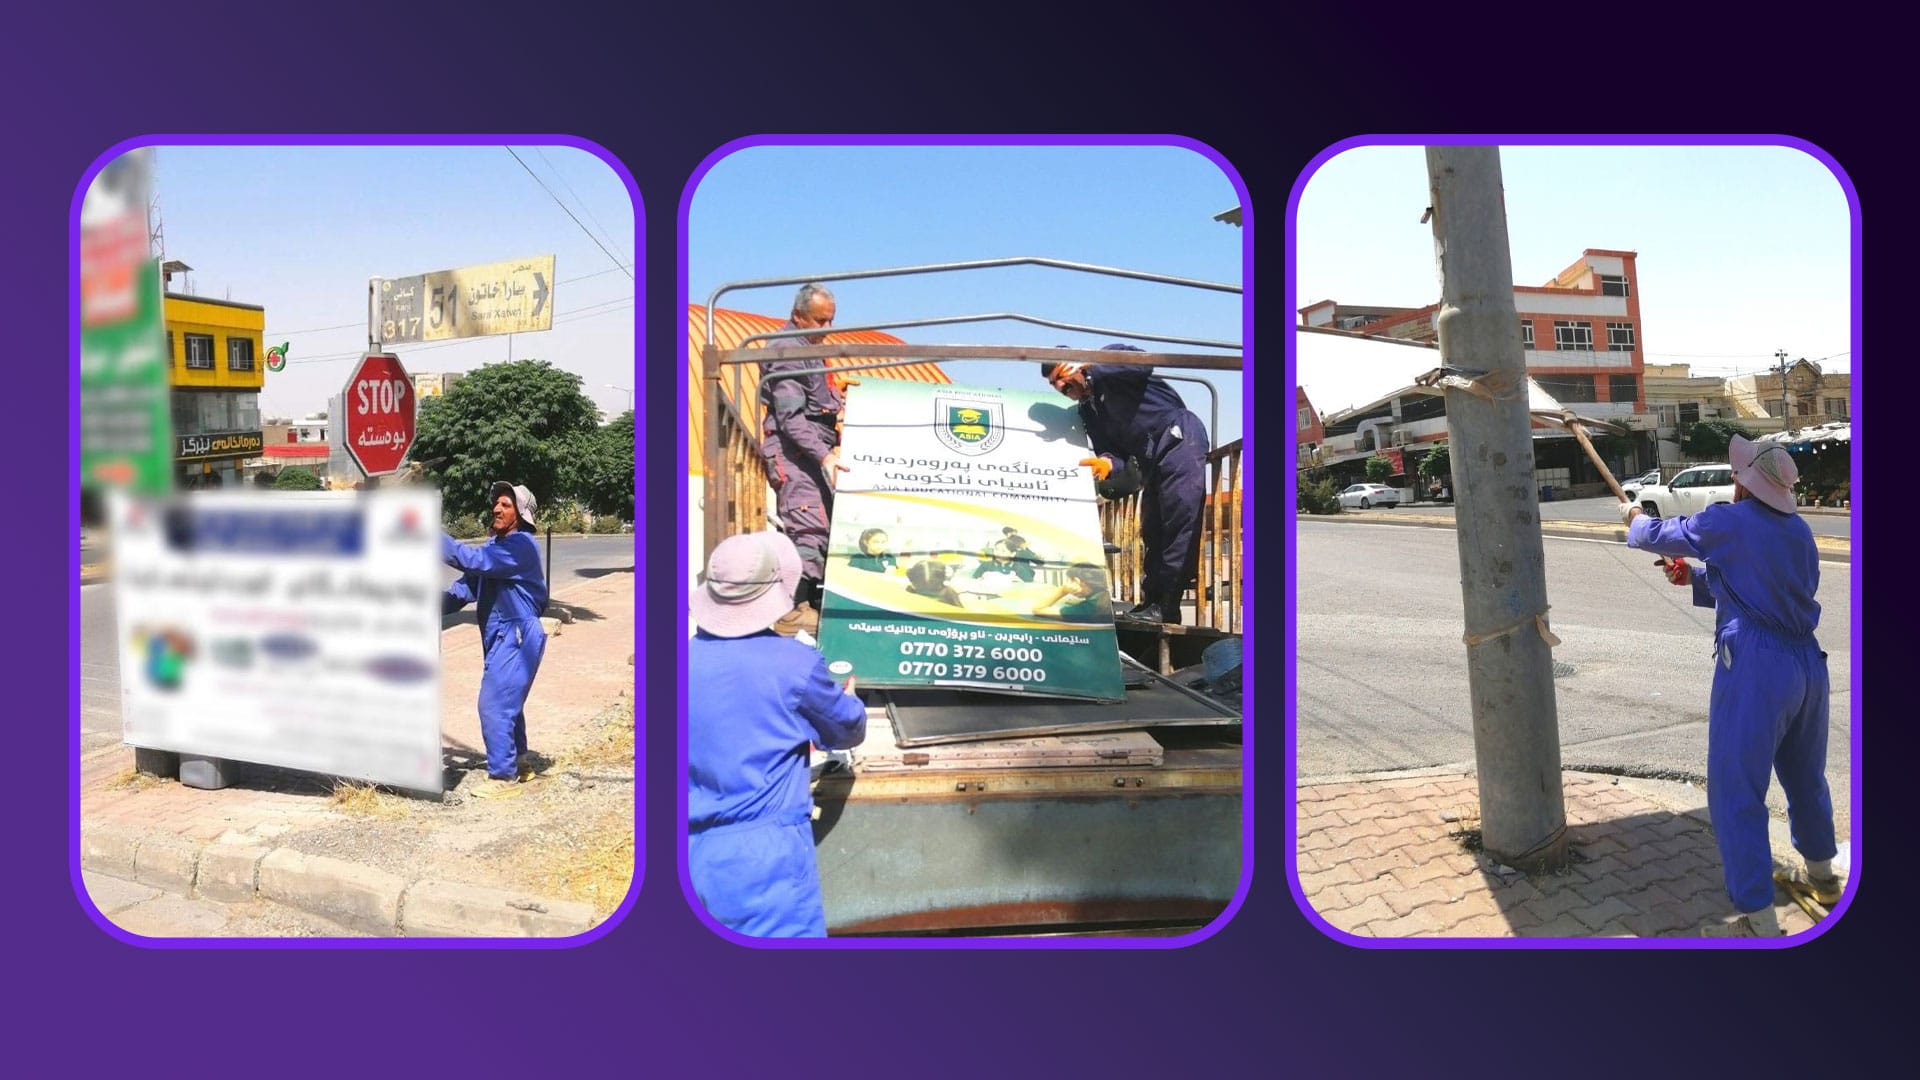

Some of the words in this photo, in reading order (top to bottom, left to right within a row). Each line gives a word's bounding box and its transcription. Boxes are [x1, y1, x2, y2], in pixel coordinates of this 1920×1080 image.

[430, 284, 457, 329] 51
[384, 317, 421, 338] 317
[357, 379, 406, 415] STOP
[959, 432, 981, 441] ASIA
[899, 641, 949, 657] 0770
[953, 644, 985, 659] 372
[990, 647, 1043, 663] 6000
[898, 660, 948, 677] 0770
[953, 664, 987, 679] 379
[992, 666, 1047, 682] 6000
